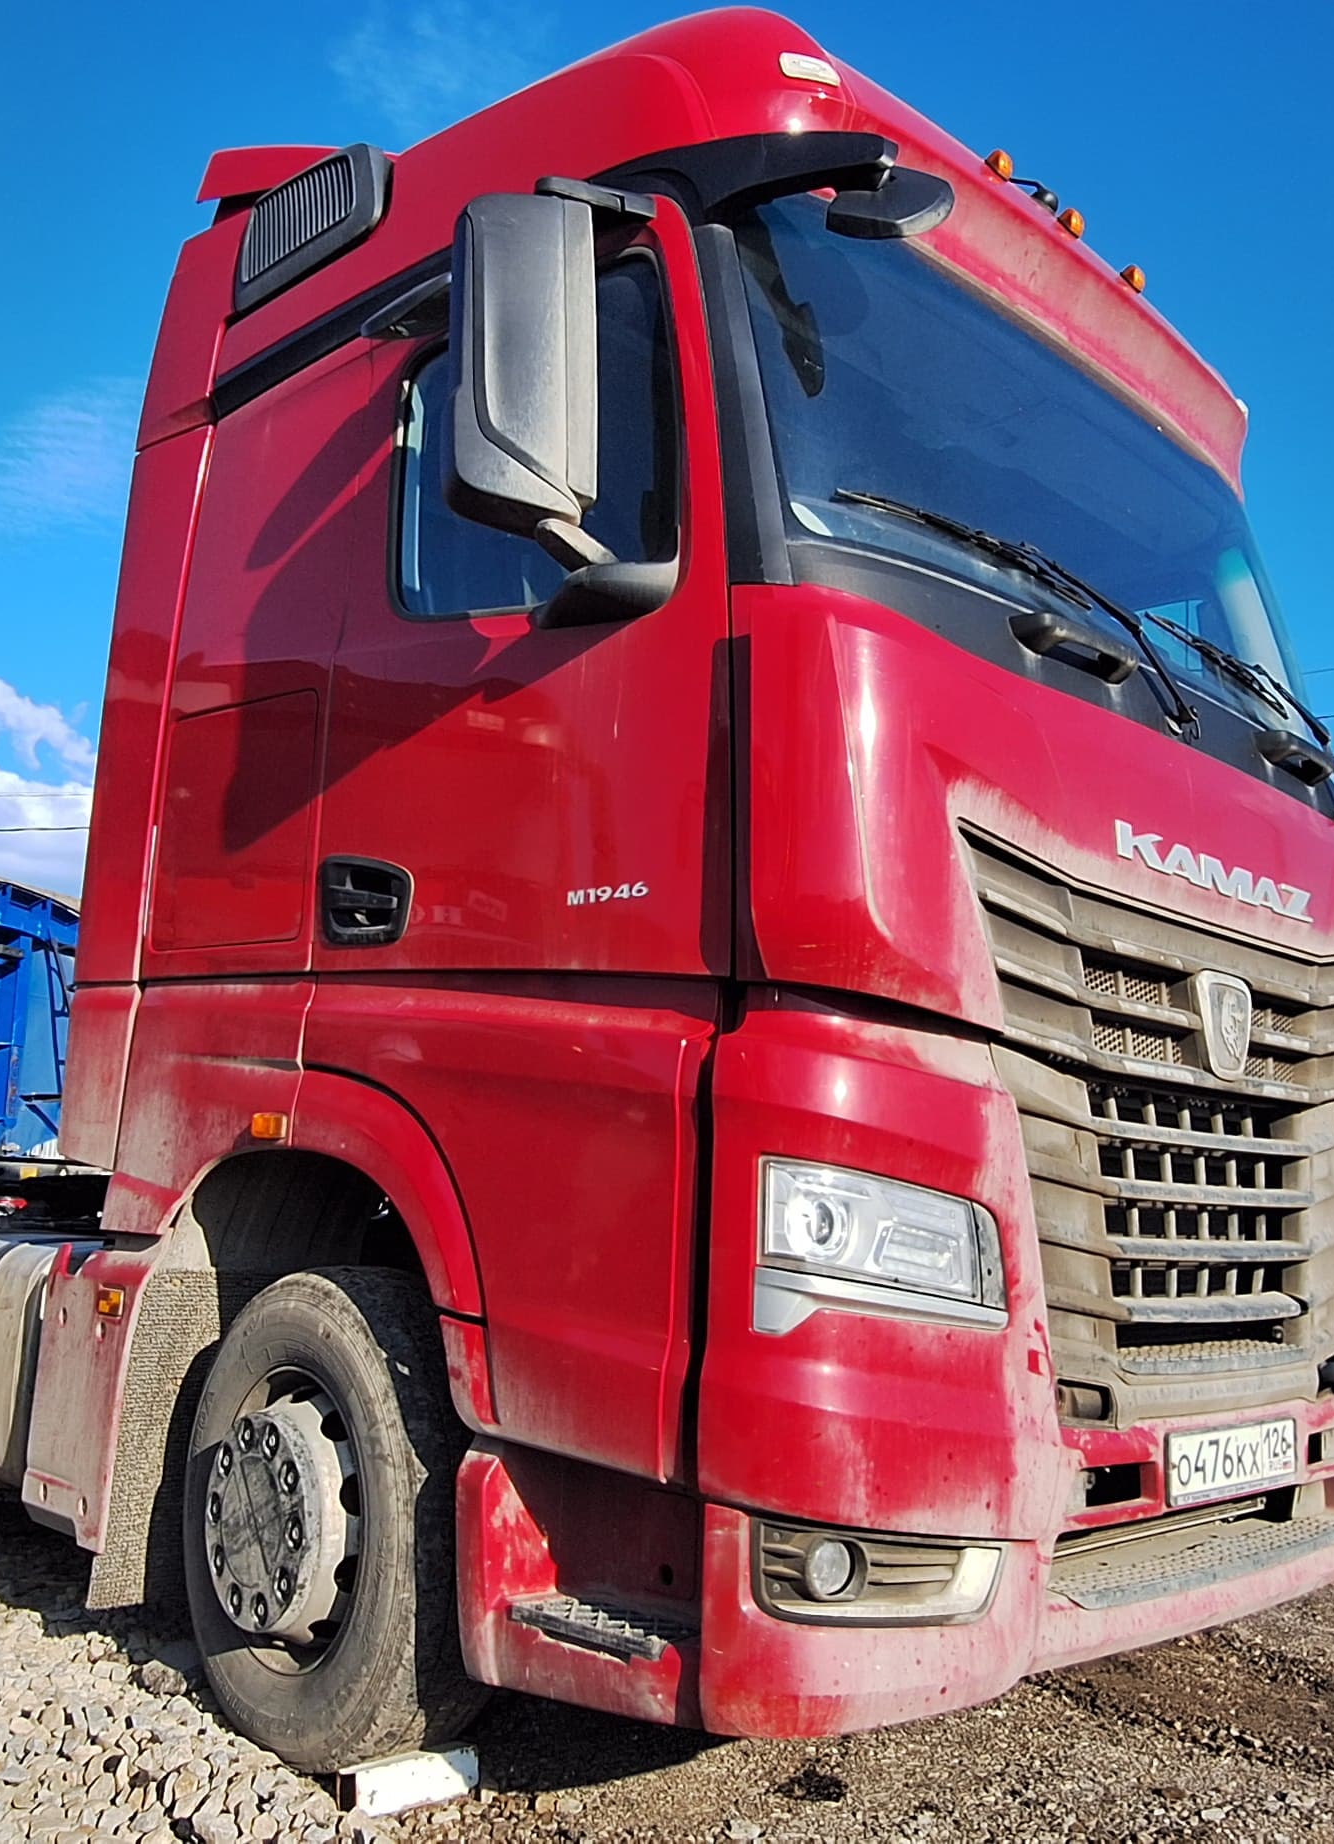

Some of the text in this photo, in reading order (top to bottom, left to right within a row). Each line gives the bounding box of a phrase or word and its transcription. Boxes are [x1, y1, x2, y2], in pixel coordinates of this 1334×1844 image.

[1114, 819, 1315, 924] KAMAZ
[566, 881, 649, 906] M1946
[1264, 1424, 1288, 1459] 126
